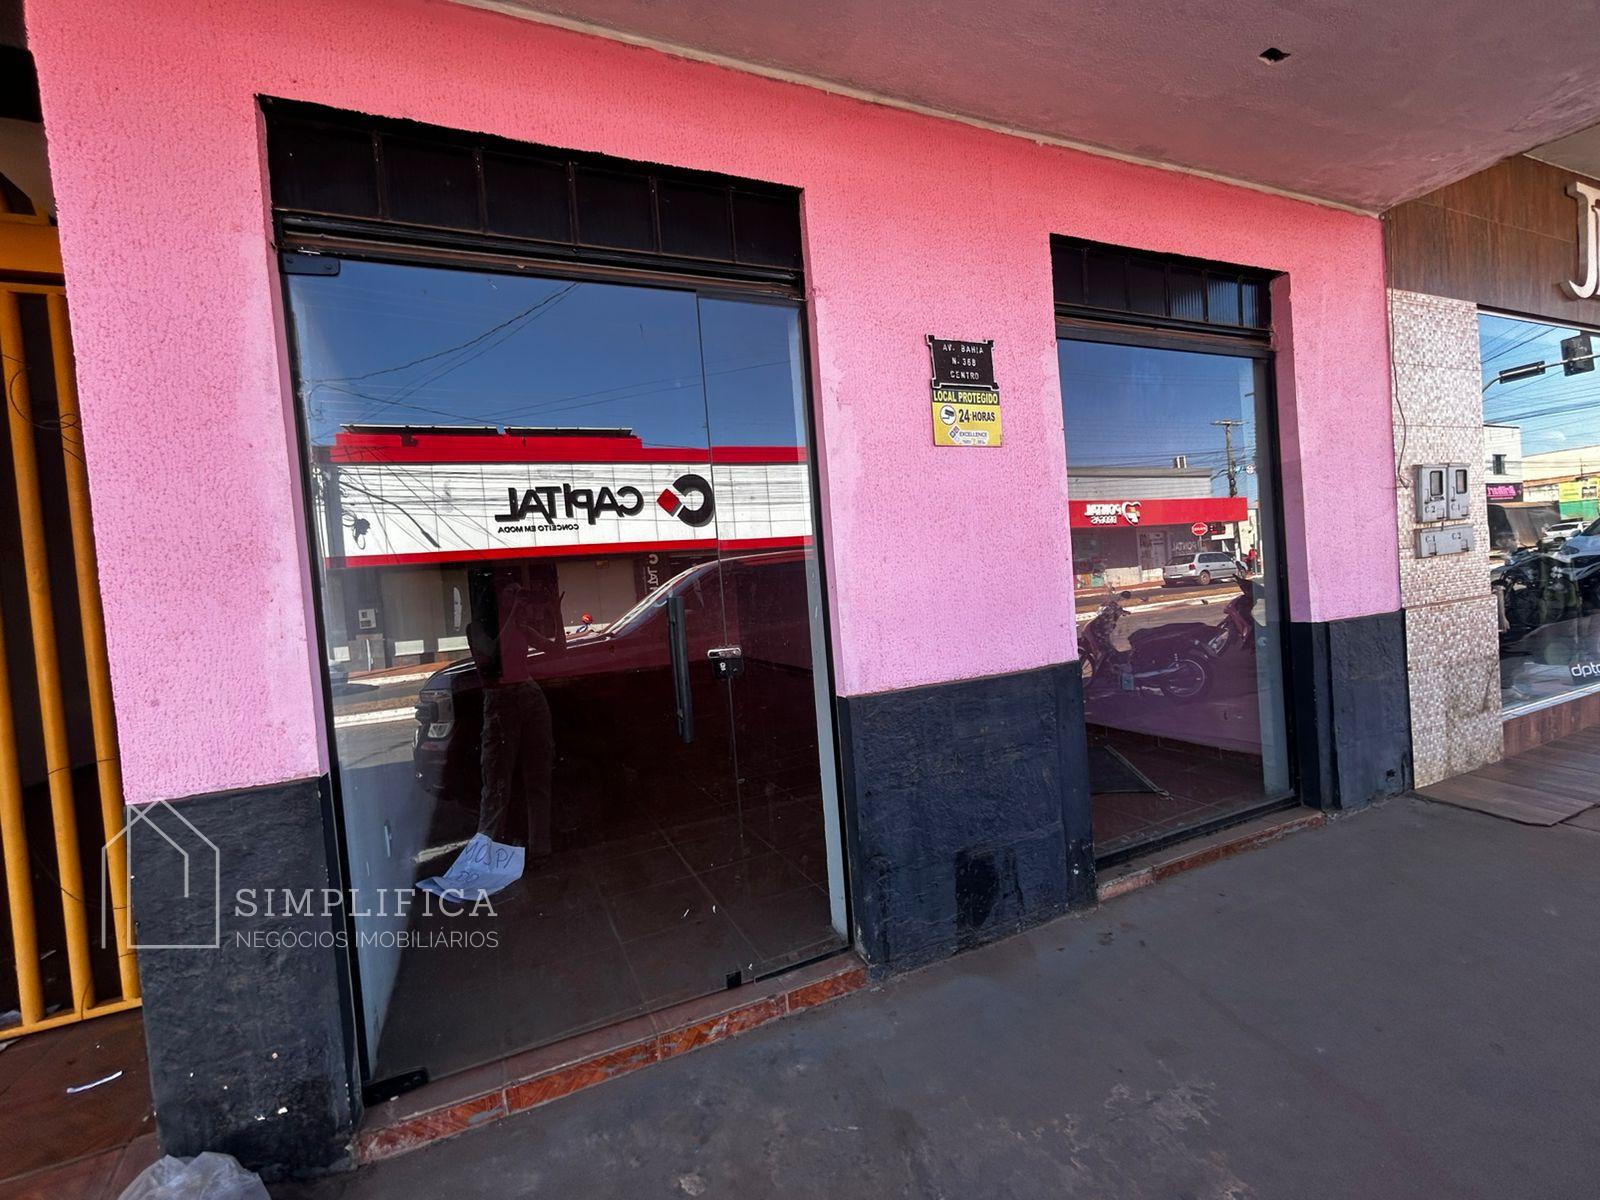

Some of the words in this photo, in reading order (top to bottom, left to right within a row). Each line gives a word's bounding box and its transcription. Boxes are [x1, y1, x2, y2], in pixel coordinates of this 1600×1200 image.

[942, 344, 955, 352] AV.
[960, 344, 984, 354] BAHIA
[949, 370, 980, 380] CENTRO
[933, 390, 957, 402] LOCAL
[958, 391, 998, 404] PROTEGIDO
[958, 409, 970, 423] 24
[972, 411, 996, 422] HORAS
